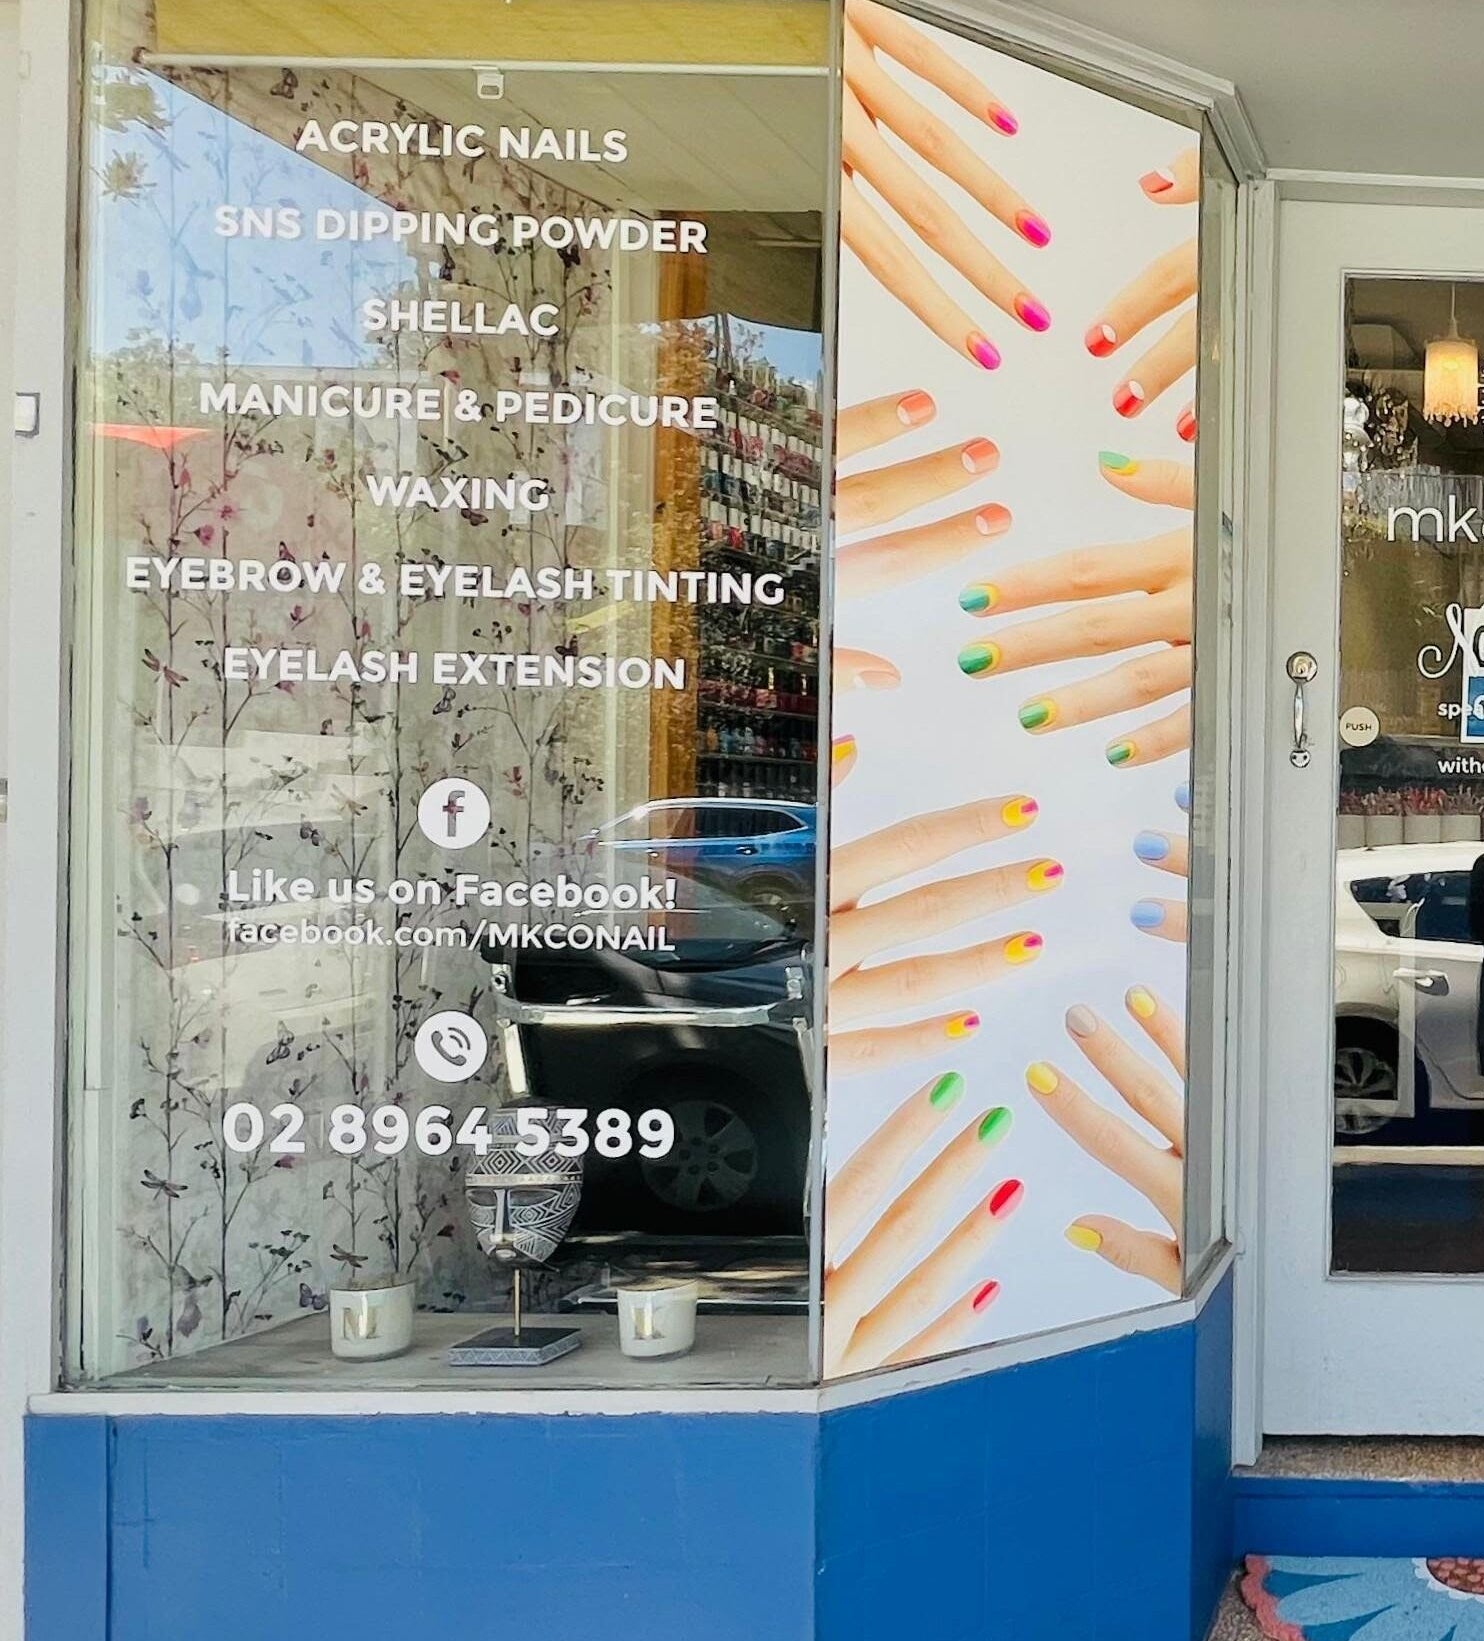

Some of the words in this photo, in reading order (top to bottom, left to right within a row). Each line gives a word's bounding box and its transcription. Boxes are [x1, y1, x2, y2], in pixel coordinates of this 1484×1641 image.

[296, 119, 485, 157] ACRYLIC
[499, 127, 628, 163] NAILS
[214, 206, 299, 241] SNS
[317, 207, 497, 247] DIPPING
[512, 219, 708, 254] POWDER
[362, 299, 559, 337] SHELLAC
[200, 382, 440, 420] MANICURE
[454, 389, 482, 422] &
[496, 391, 716, 428] PEDICURE
[367, 475, 549, 511] WAXING
[127, 557, 346, 592] EYEBROW
[358, 562, 386, 594] &
[401, 565, 593, 600] EYELASH
[608, 569, 785, 606] TINTING
[224, 648, 416, 685] EYELASH
[434, 652, 685, 690] EXTENSION
[1345, 722, 1372, 731] PUSH
[228, 870, 314, 901] Like
[328, 880, 376, 904] us
[389, 880, 441, 906] on
[456, 874, 677, 910] Facebook!
[228, 917, 675, 951] facebook.com/MKCONAIL
[223, 1103, 305, 1154] 02
[329, 1104, 493, 1156] 8964
[516, 1107, 676, 1159] 5389
